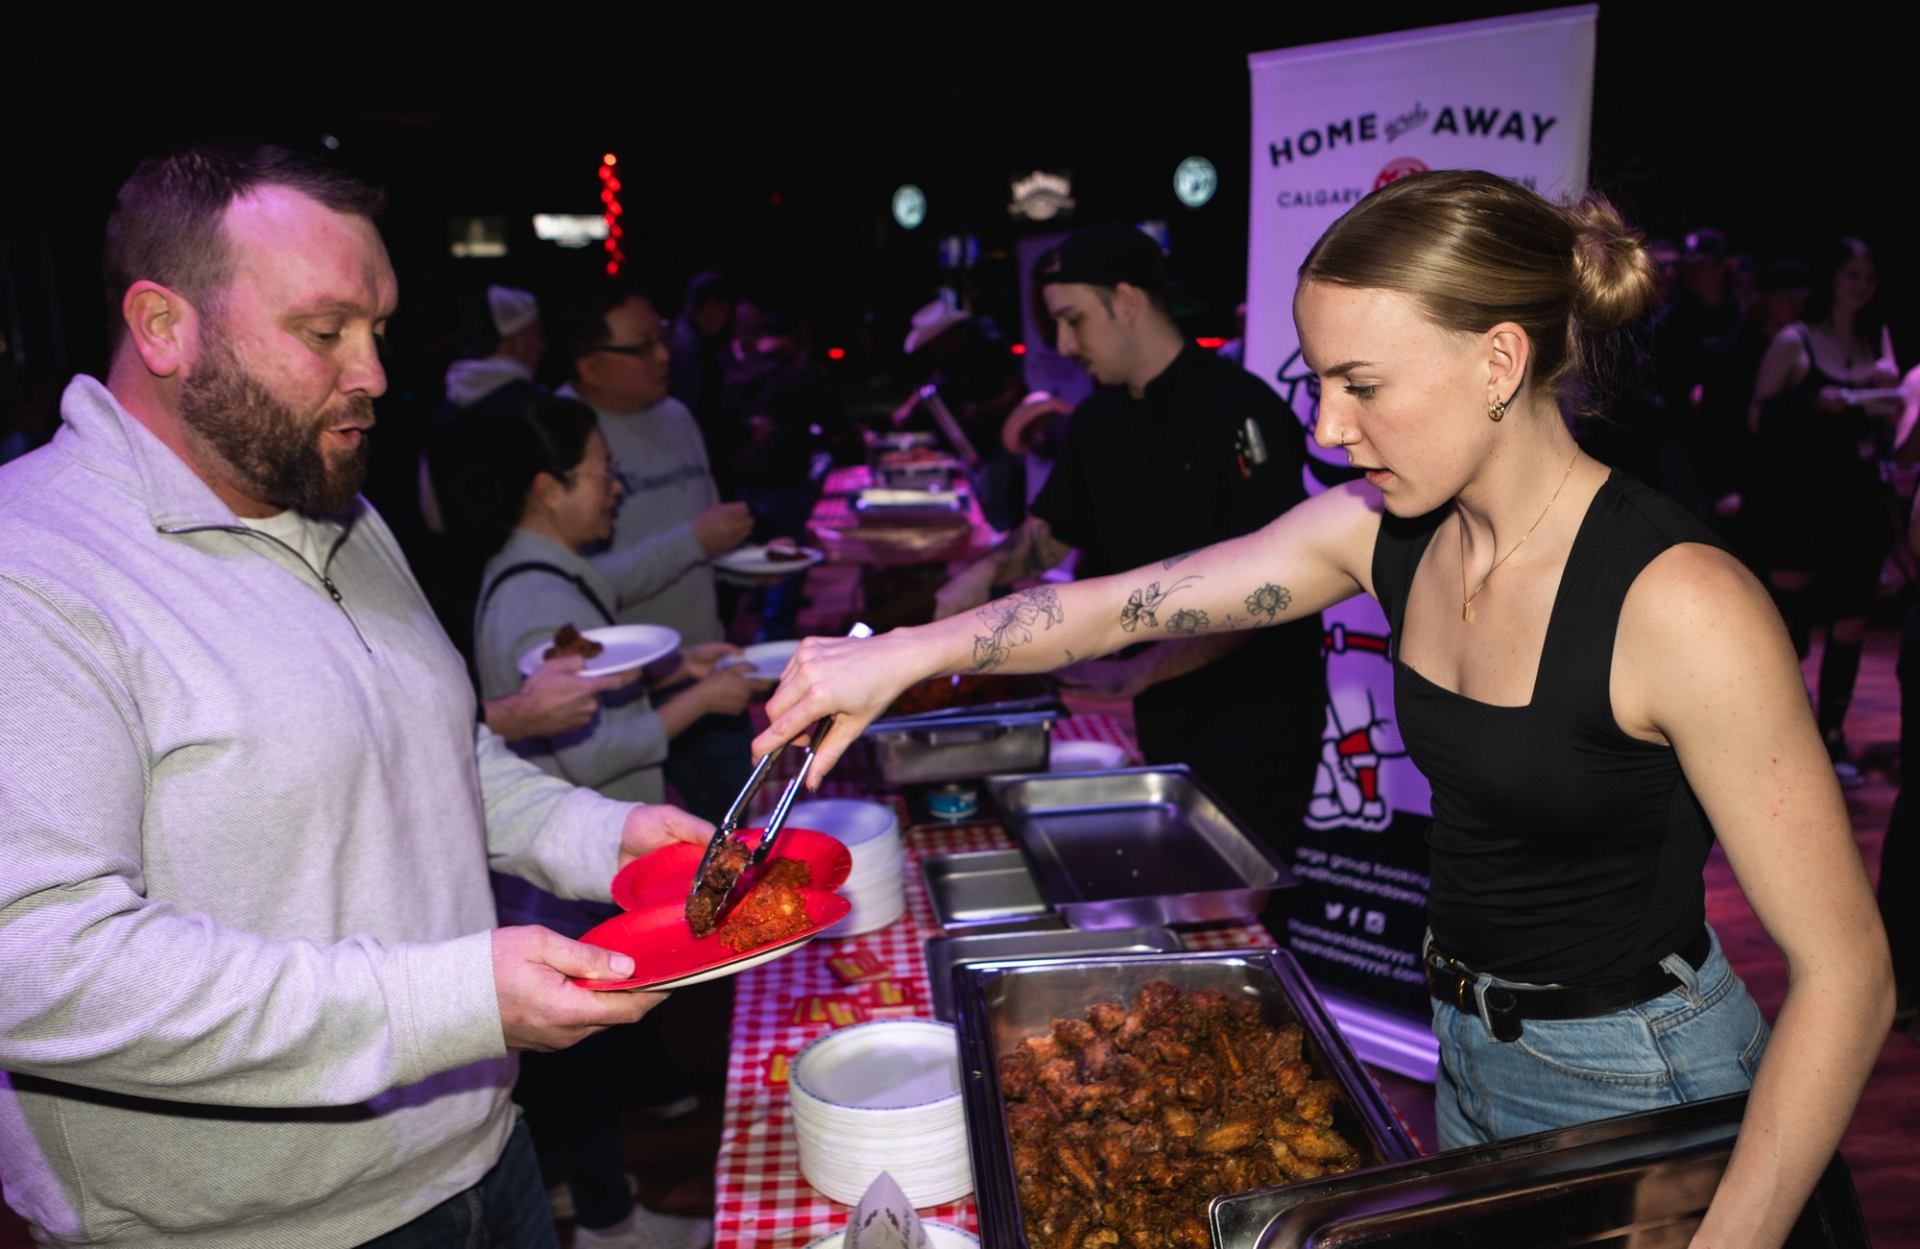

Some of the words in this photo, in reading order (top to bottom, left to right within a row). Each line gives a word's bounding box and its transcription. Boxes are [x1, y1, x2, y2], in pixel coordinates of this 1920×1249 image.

[1269, 113, 1377, 166] HOME
[1432, 105, 1558, 145] AWAY
[1330, 855, 1371, 873] group
